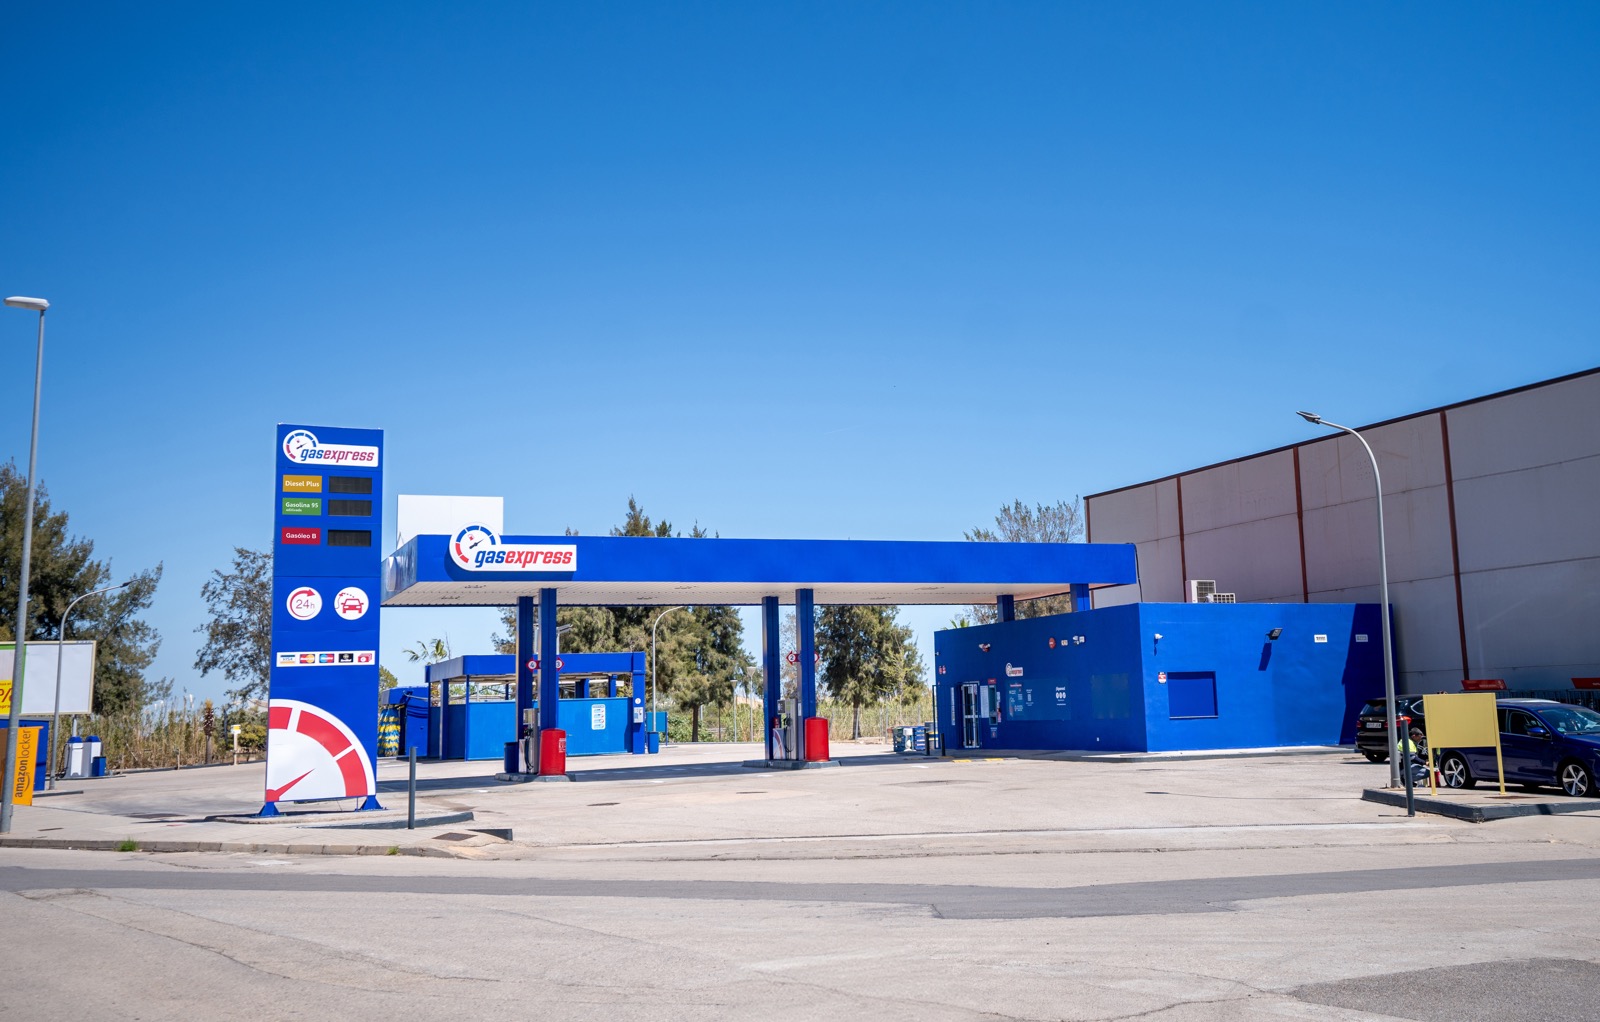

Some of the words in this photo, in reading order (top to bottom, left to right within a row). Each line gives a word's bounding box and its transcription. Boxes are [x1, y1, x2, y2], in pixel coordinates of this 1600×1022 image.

[300, 449, 374, 462] gasexpress
[474, 550, 572, 568] gasexpress
[295, 599, 315, 610] 24h
[18, 729, 31, 759] locker
[15, 759, 28, 798] amazon
